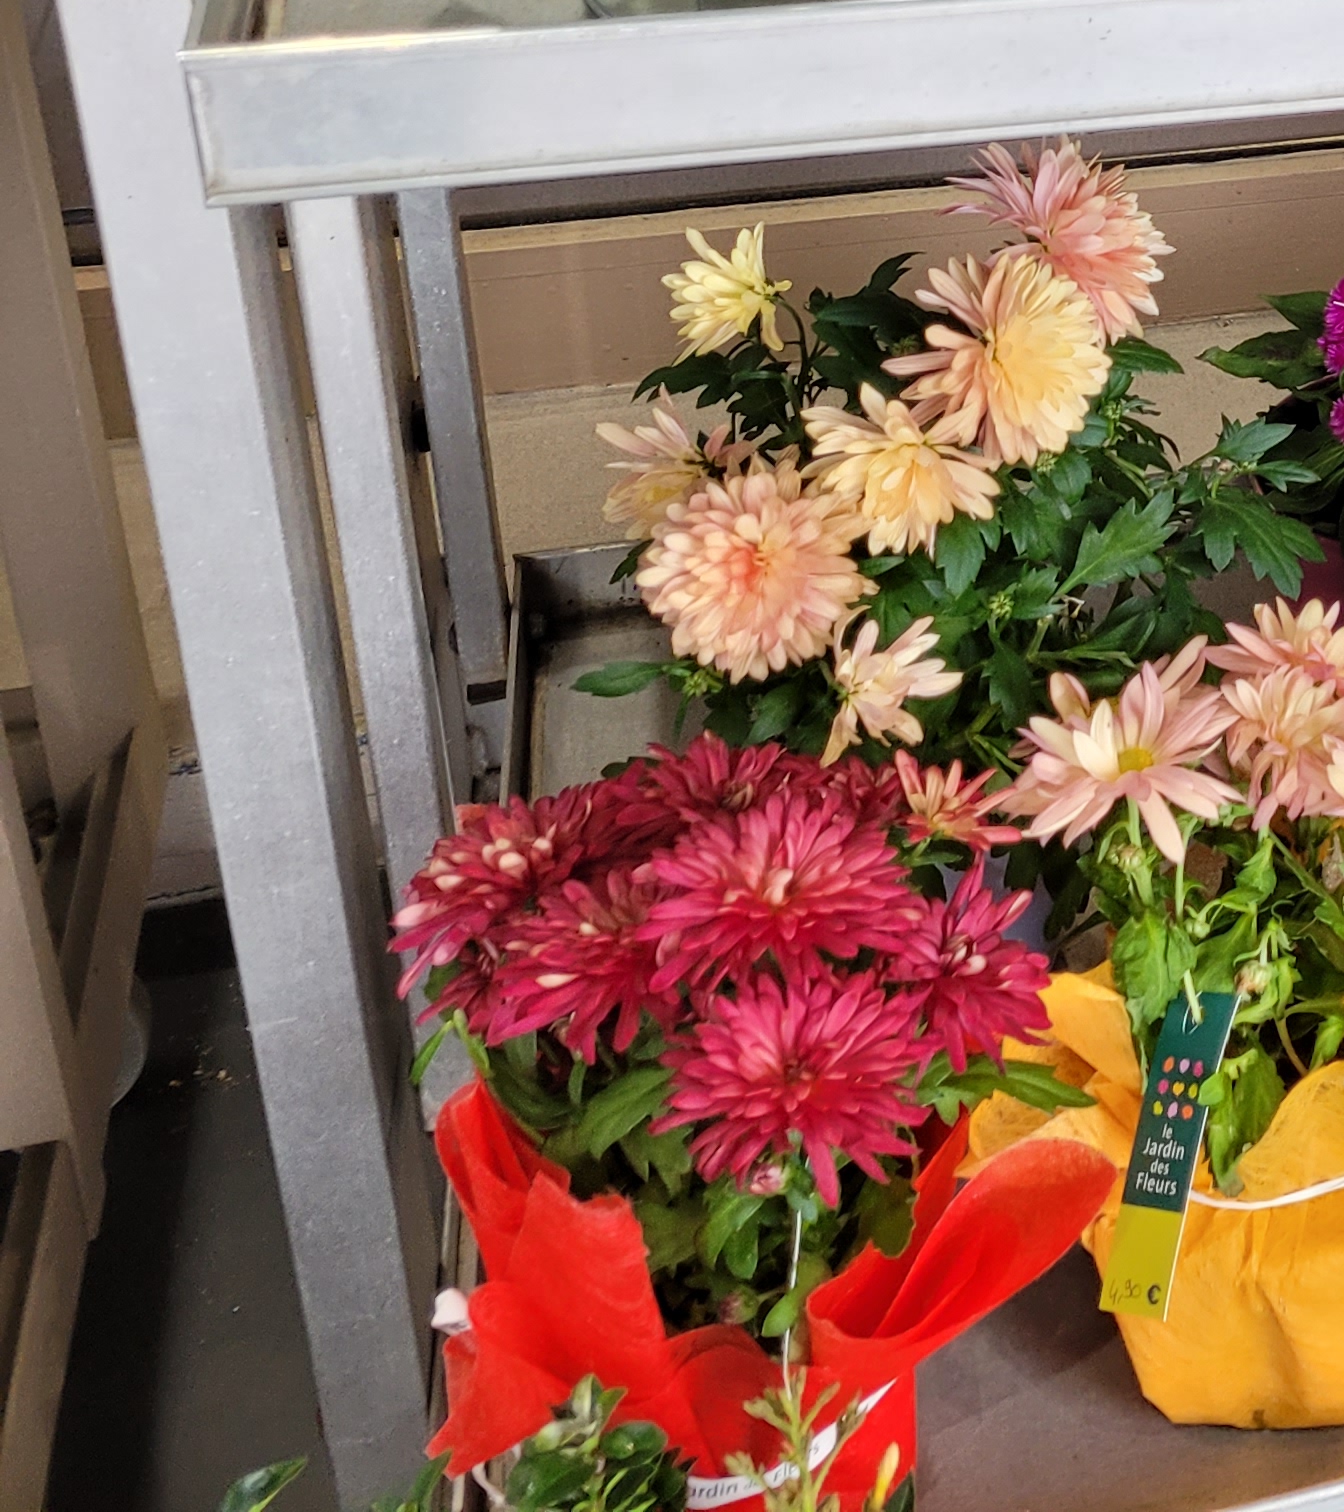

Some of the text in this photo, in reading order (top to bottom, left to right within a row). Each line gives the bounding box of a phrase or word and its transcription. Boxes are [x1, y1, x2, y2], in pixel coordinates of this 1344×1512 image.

[1162, 1123, 1173, 1139] le
[1143, 1137, 1185, 1161] Jardin
[1150, 1159, 1169, 1176] des
[1135, 1172, 1178, 1196] Fleurs
[1147, 1285, 1161, 1305] €
